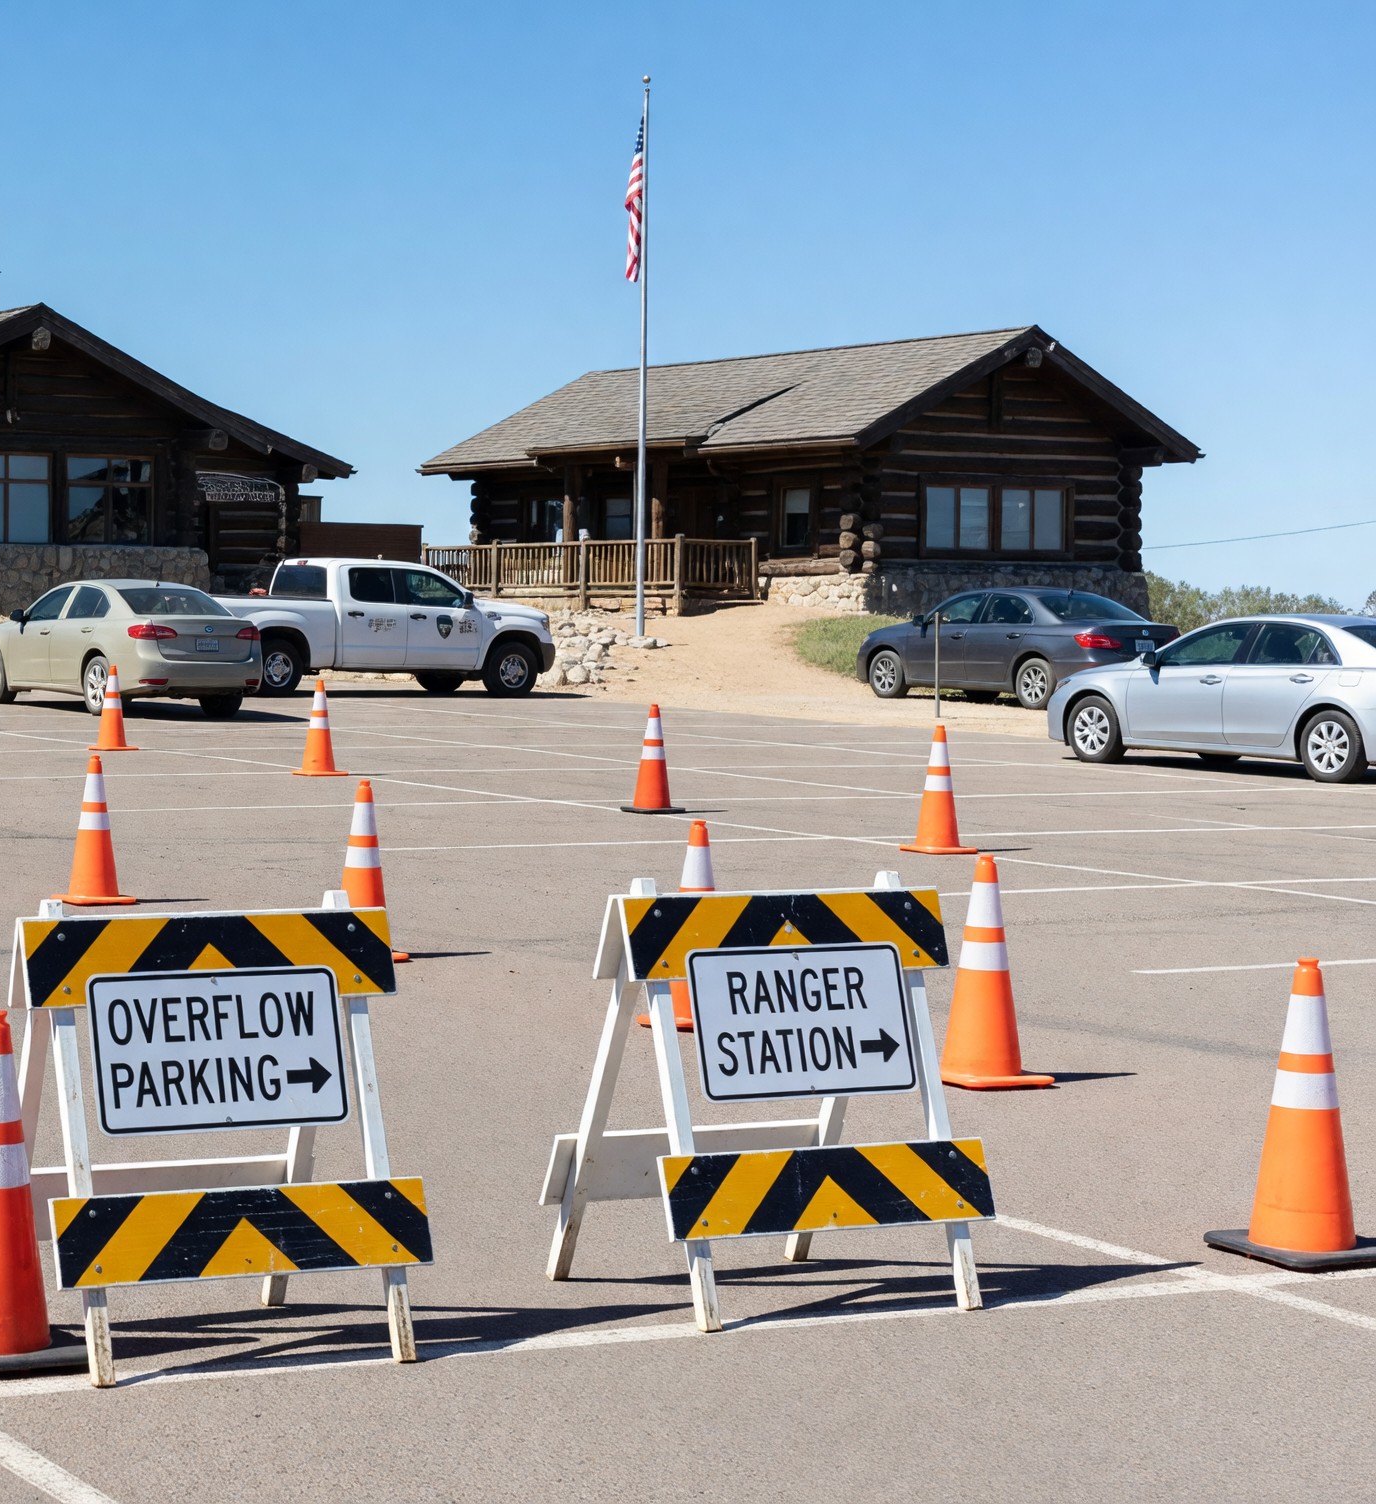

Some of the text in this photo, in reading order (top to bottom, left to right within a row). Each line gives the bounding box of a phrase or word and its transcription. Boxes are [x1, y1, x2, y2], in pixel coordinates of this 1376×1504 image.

[726, 966, 867, 1014] RANGER
[108, 991, 314, 1045] OVERFLOW
[717, 1026, 857, 1076] STATION
[110, 1054, 281, 1109] PARKING
